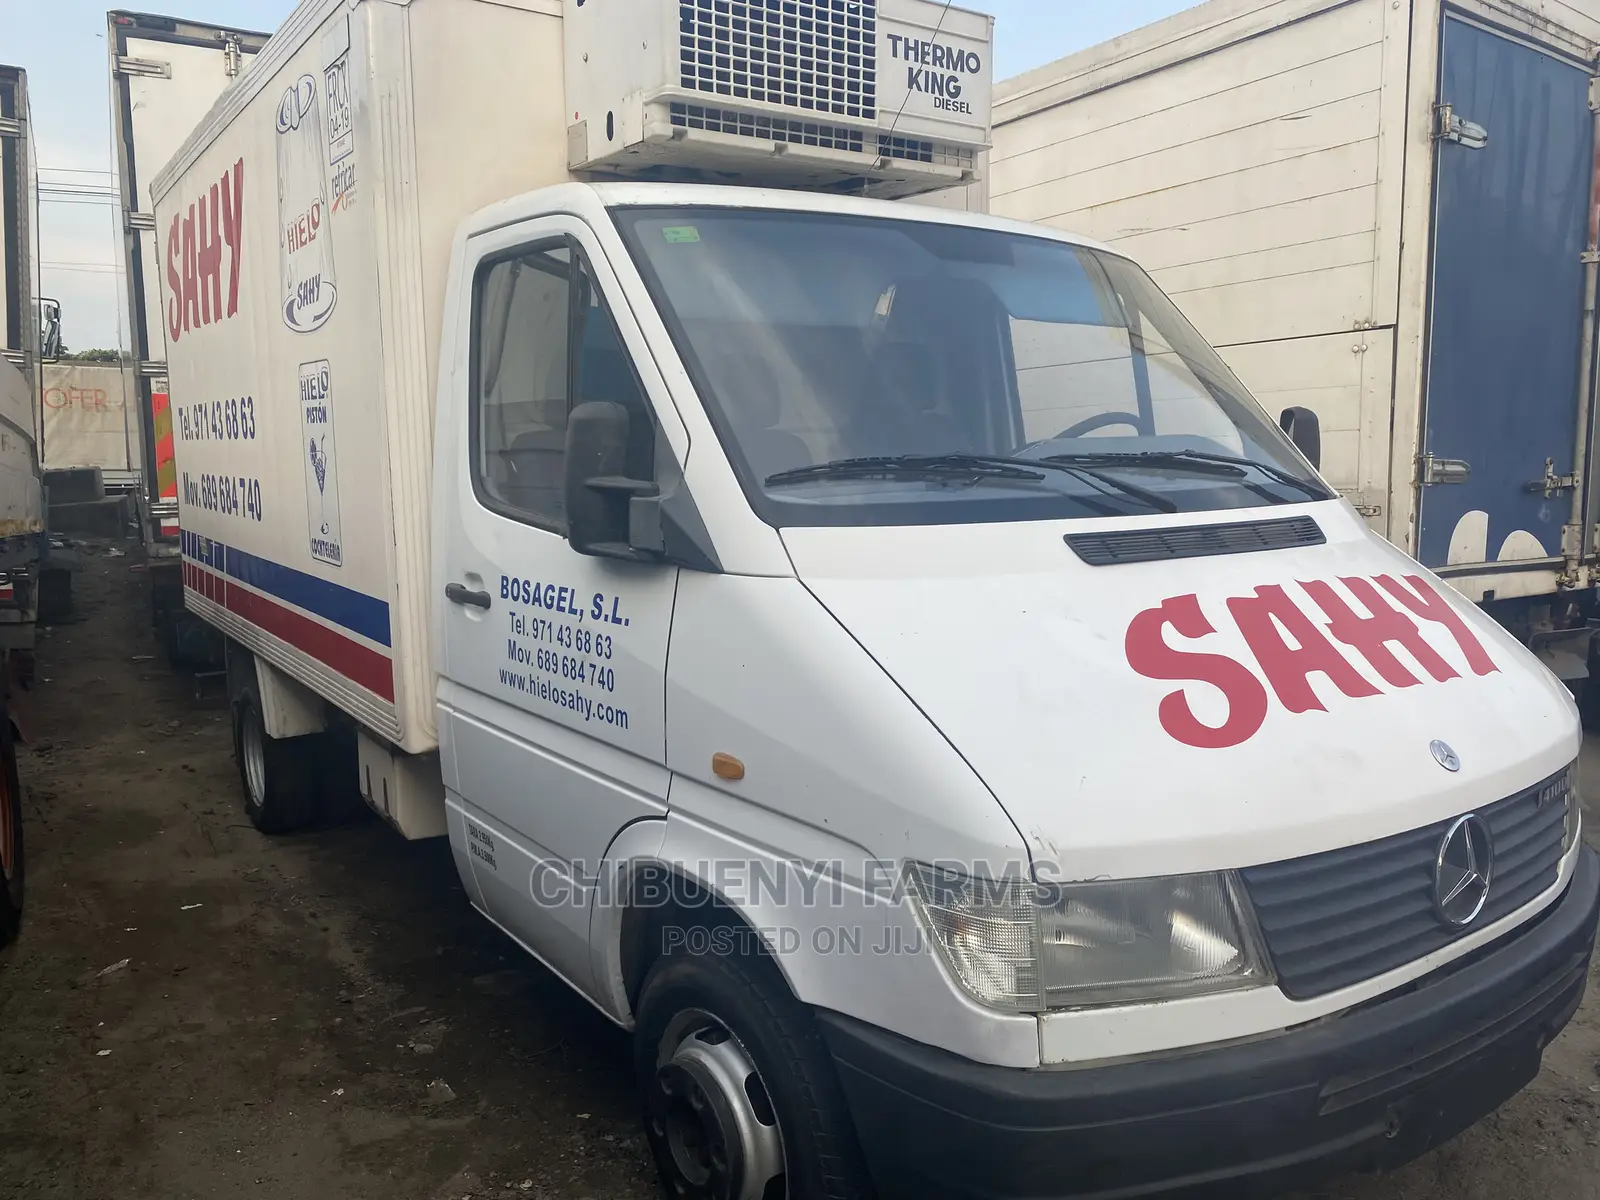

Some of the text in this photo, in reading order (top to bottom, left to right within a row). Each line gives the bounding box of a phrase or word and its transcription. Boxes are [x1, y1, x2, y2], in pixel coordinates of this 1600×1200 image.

[887, 33, 981, 74] THERMO
[327, 59, 349, 117] FRCX
[907, 66, 962, 99] KING
[933, 96, 972, 115] DIESEL
[329, 106, 349, 139] 04-19
[167, 157, 244, 342] SAHY
[287, 201, 320, 255] HIELO
[297, 273, 321, 310] SAHY
[300, 369, 329, 401] HIELO
[178, 395, 256, 441] Tel. 971 43 68 63
[182, 471, 262, 522] Mov. 689 684 740
[500, 575, 631, 627] BOSAGEL, S.L.
[509, 611, 613, 660] Tel. 971 43 68 63
[507, 638, 615, 693] Mov. 689 684 740
[1125, 573, 1502, 749] SAHY
[499, 667, 630, 730] www.hielosahy.com
